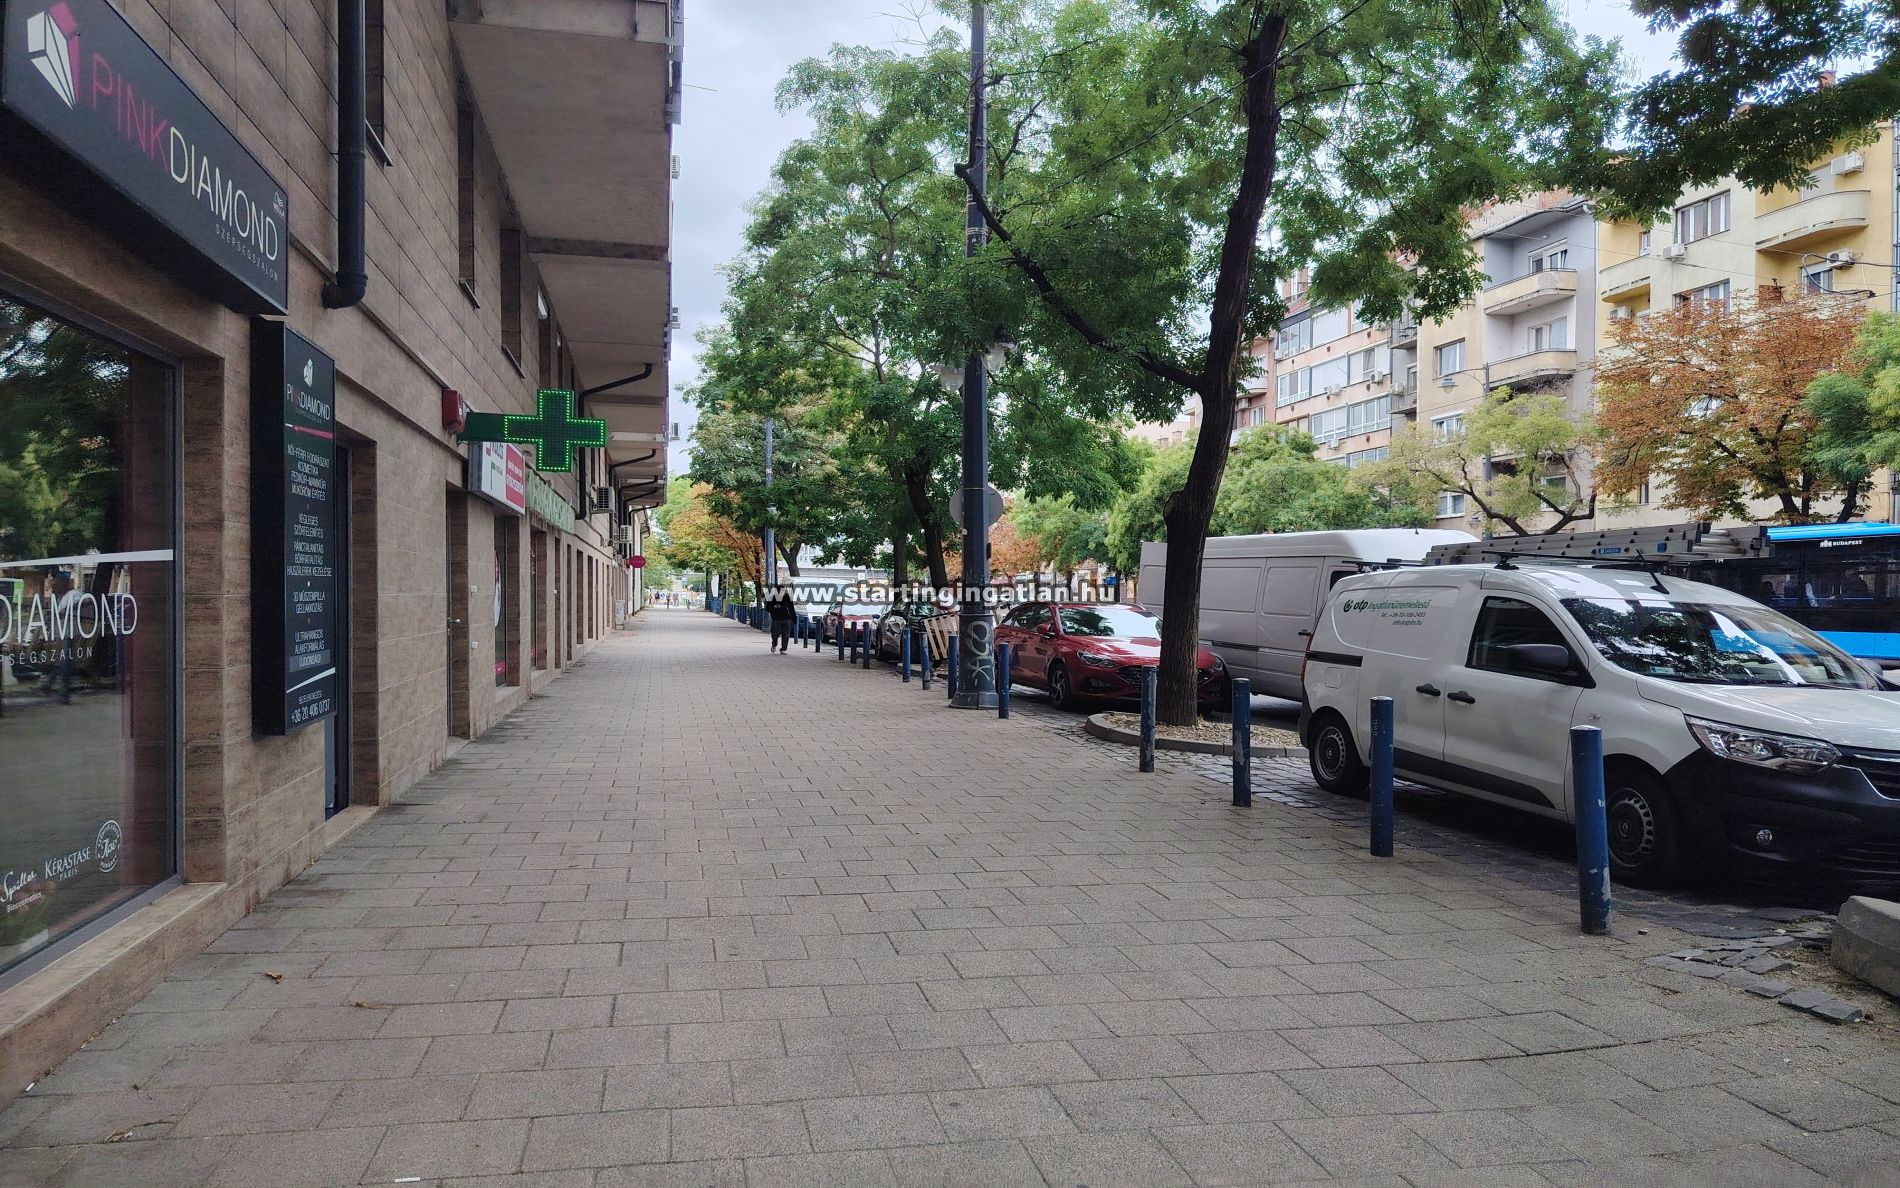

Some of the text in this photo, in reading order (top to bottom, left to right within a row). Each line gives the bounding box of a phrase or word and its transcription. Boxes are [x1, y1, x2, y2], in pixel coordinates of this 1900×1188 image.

[286, 383, 331, 420] PIDIAMOND
[1353, 599, 1369, 613] otp
[302, 706, 309, 720] 20
[45, 846, 91, 880] KÉRASTASE
[59, 868, 78, 882] PARIS
